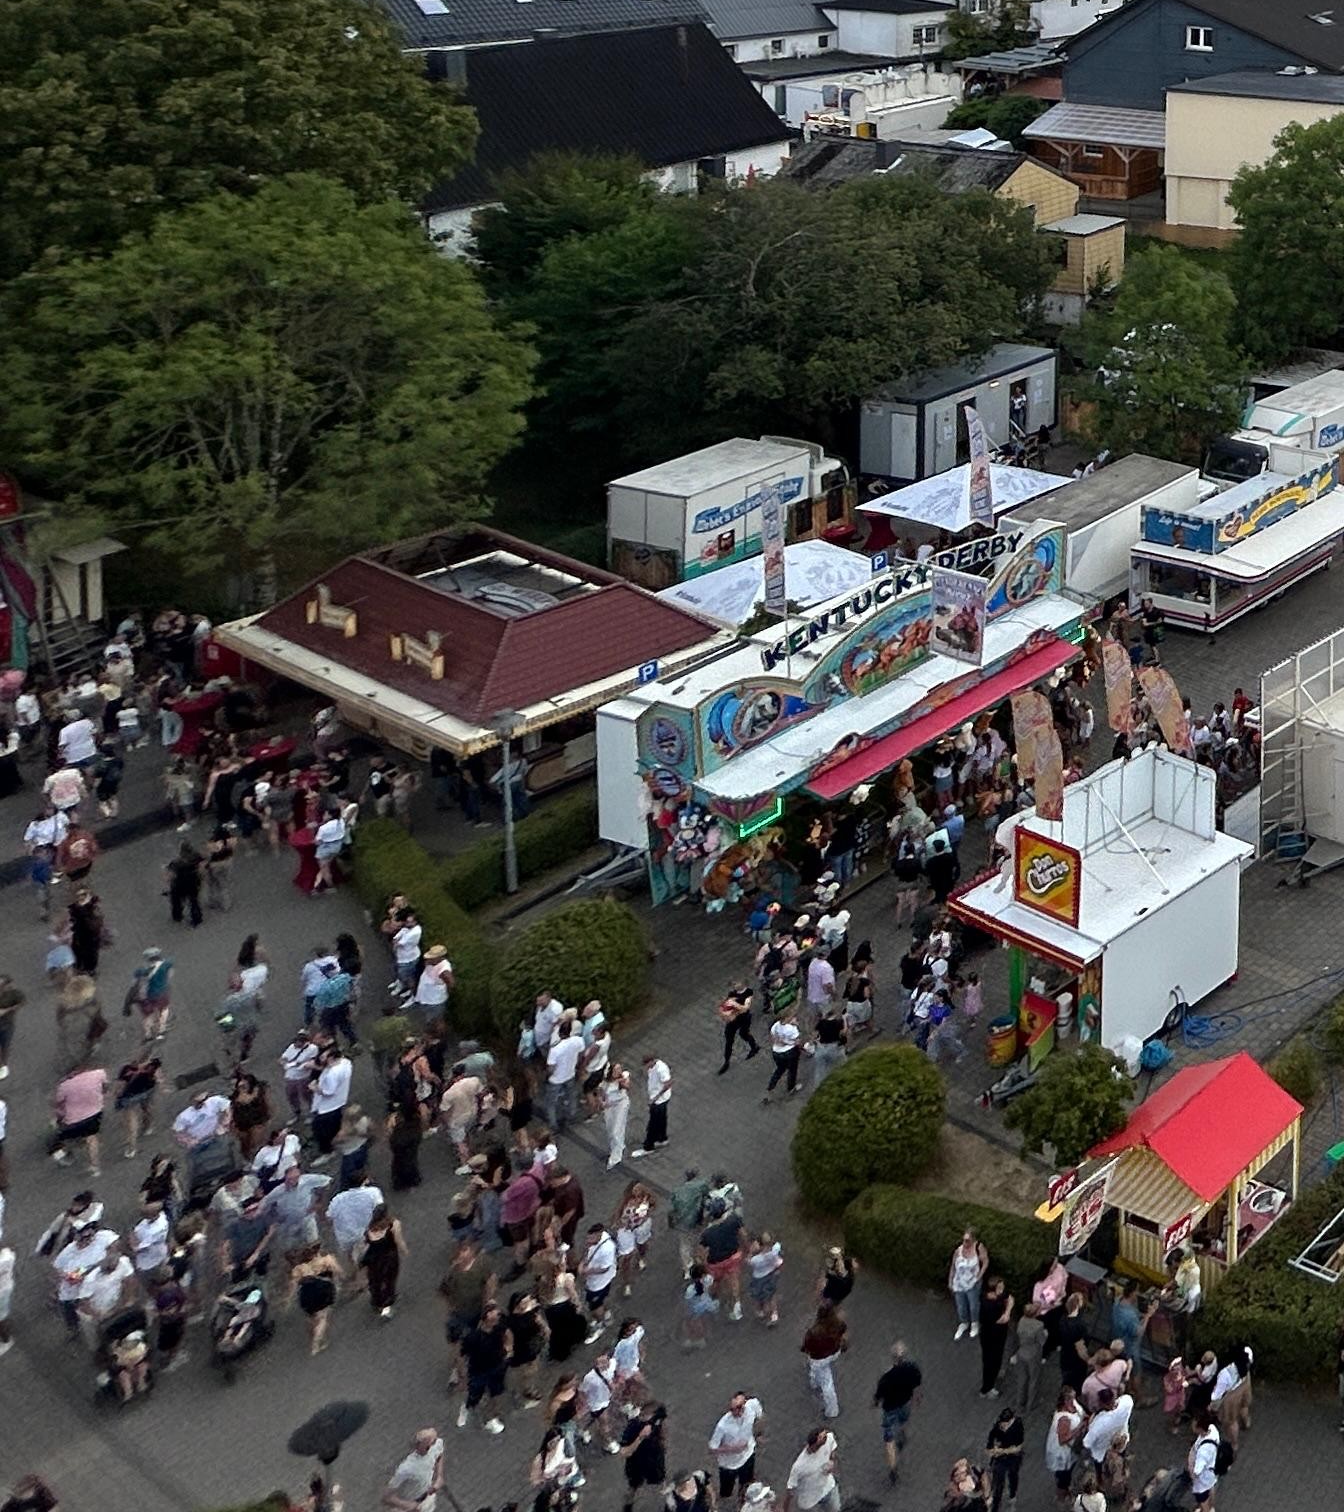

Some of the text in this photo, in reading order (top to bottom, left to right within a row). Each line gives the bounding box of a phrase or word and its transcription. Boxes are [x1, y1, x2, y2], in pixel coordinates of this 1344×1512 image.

[760, 565, 932, 672] KENTUCKY
[938, 531, 1025, 569] DERBY
[641, 662, 656, 681] P
[1026, 860, 1070, 894] Churros
[1033, 855, 1054, 873] Don
